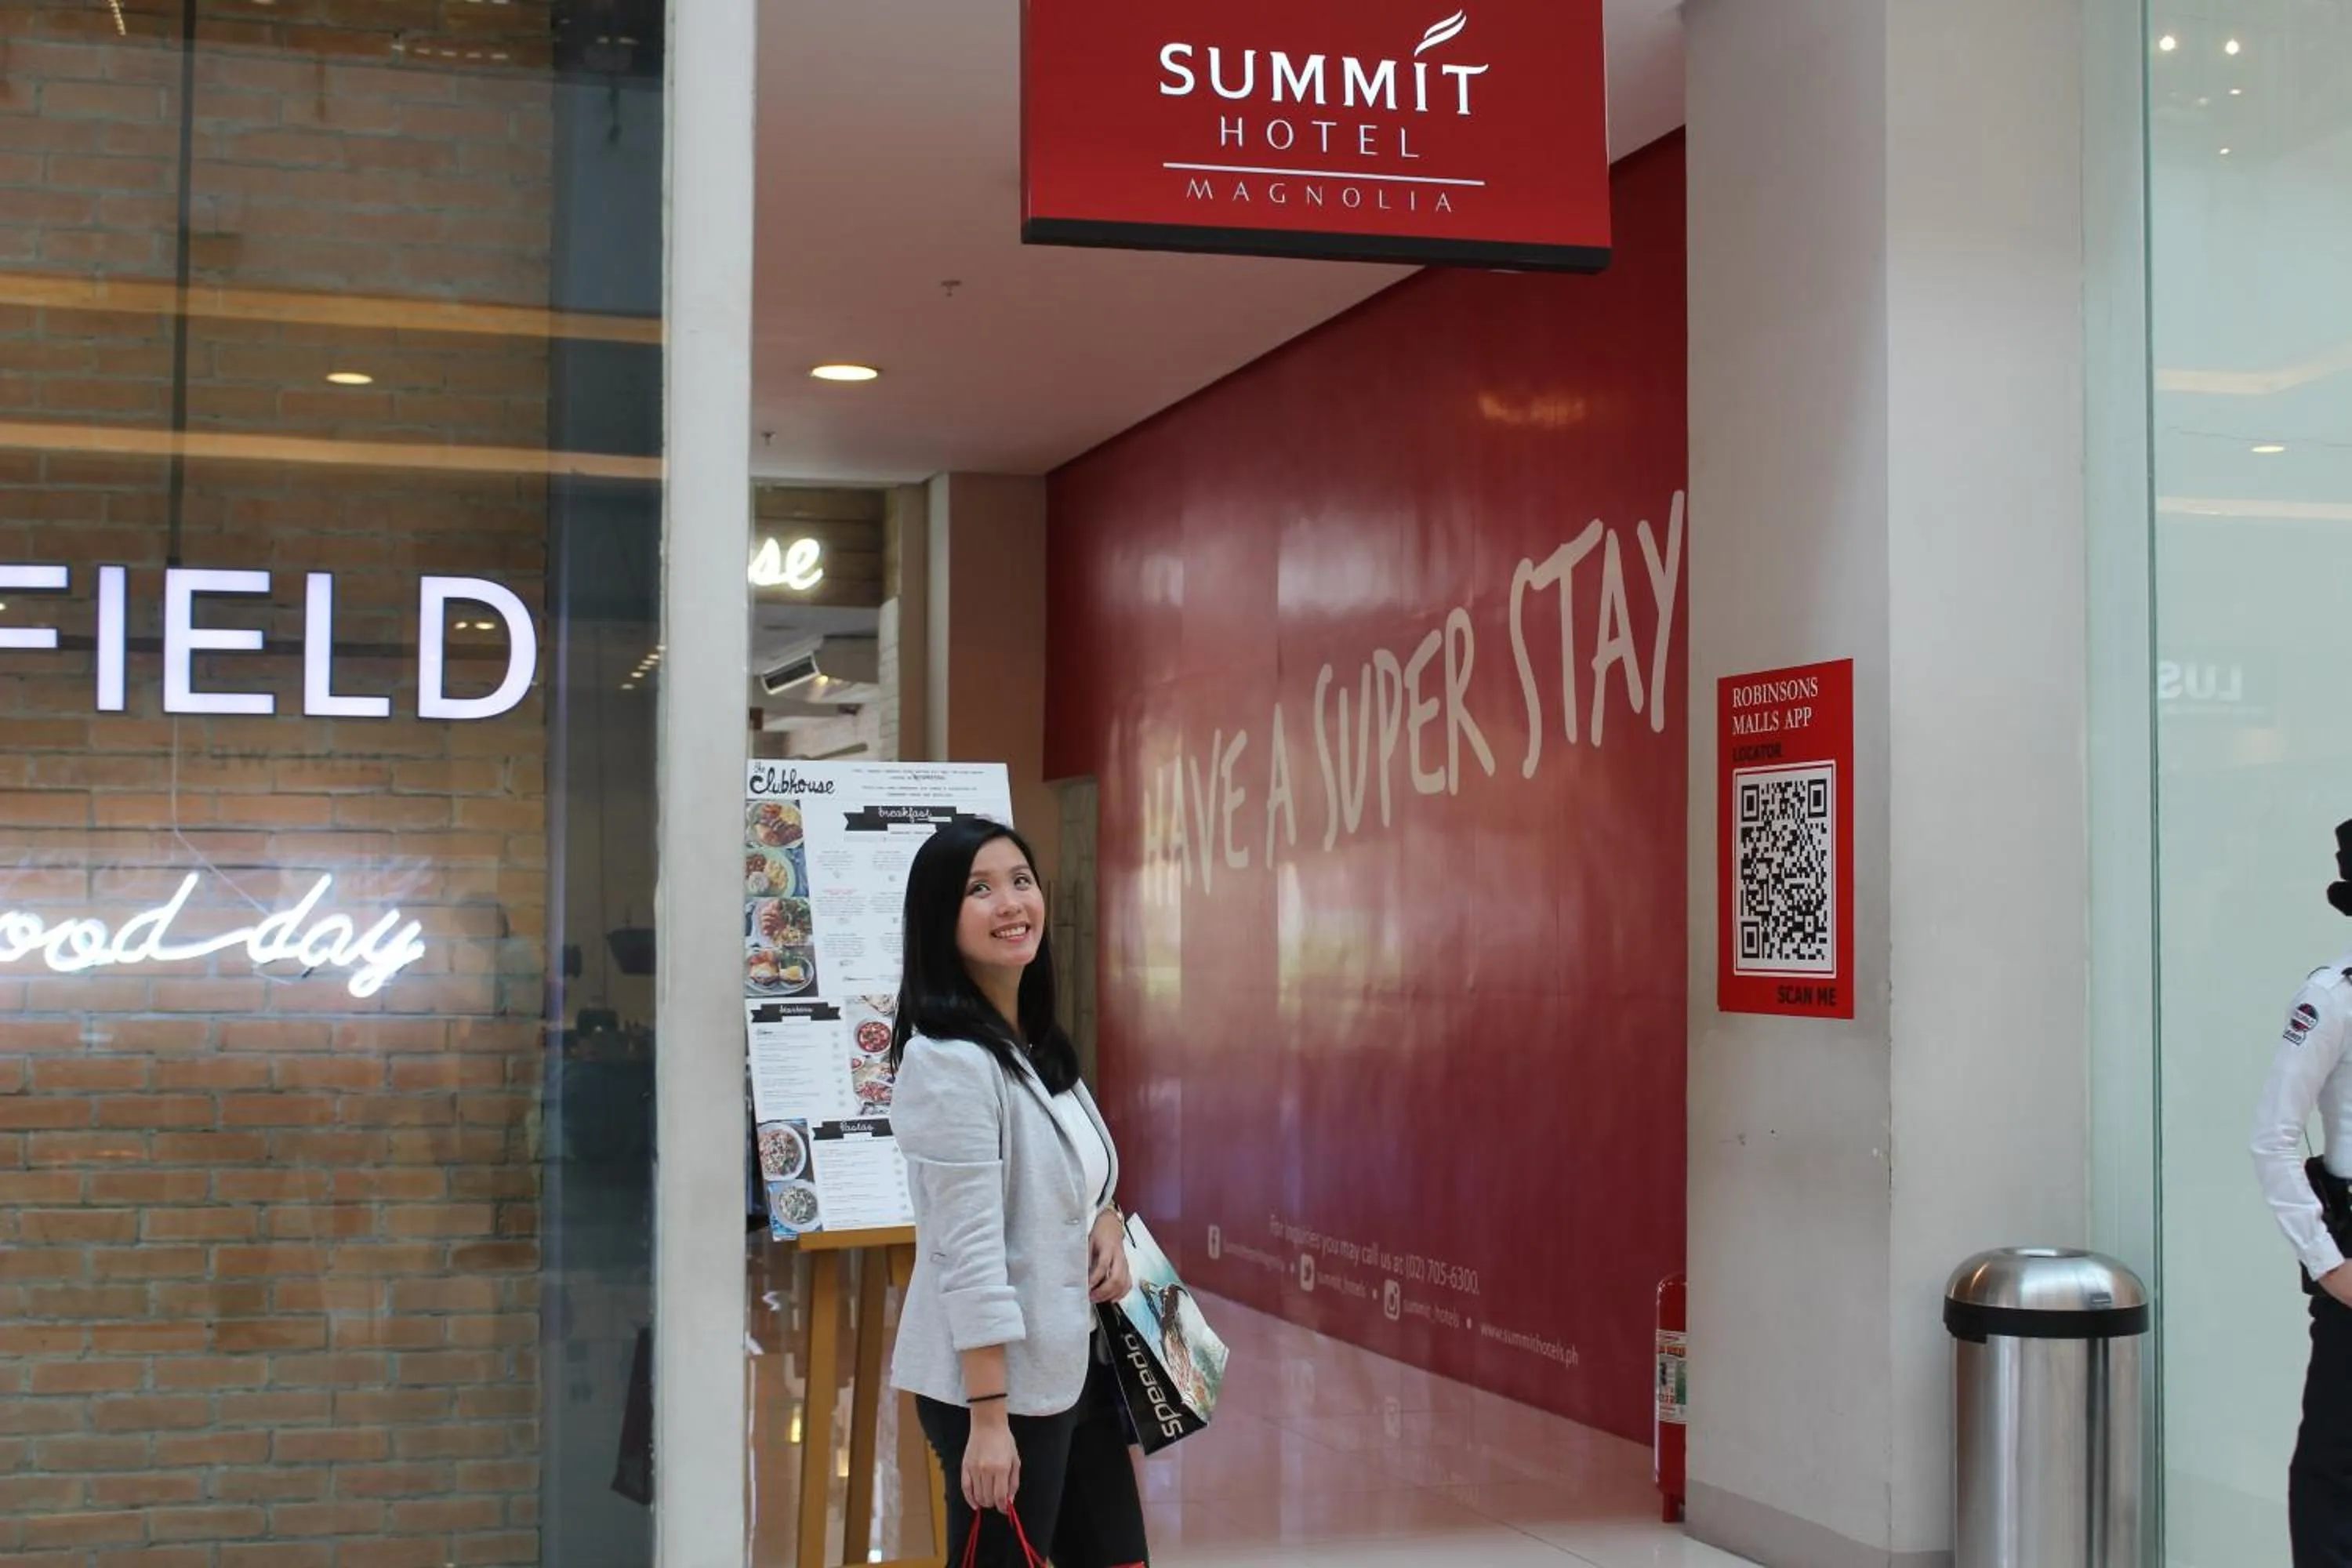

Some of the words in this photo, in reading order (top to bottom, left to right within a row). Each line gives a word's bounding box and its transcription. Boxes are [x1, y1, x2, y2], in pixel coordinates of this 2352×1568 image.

[1160, 41, 1490, 116] SUMMIT
[1220, 116, 1420, 158] HOTEL
[1186, 177, 1453, 213] MAGNOLIA
[1143, 728, 1249, 906] HAVE
[1266, 702, 1297, 869] A
[1314, 606, 1495, 852] SUPER
[1508, 488, 1685, 779] STAY
[1732, 676, 1819, 709] ROBINSONS
[1732, 710, 1780, 736] MALLS
[1783, 706, 1813, 730] APP
[246, 872, 426, 999] day
[1777, 985, 1813, 1005] SCAN
[1817, 987, 1837, 1007] ME
[1322, 1236, 1339, 1260] you
[1340, 1240, 1360, 1268] may
[1362, 1242, 1379, 1267] call
[1381, 1253, 1392, 1271] us
[1393, 1255, 1403, 1276] at
[1406, 1253, 1425, 1284] (02)
[1122, 1332, 1185, 1438] speedo
